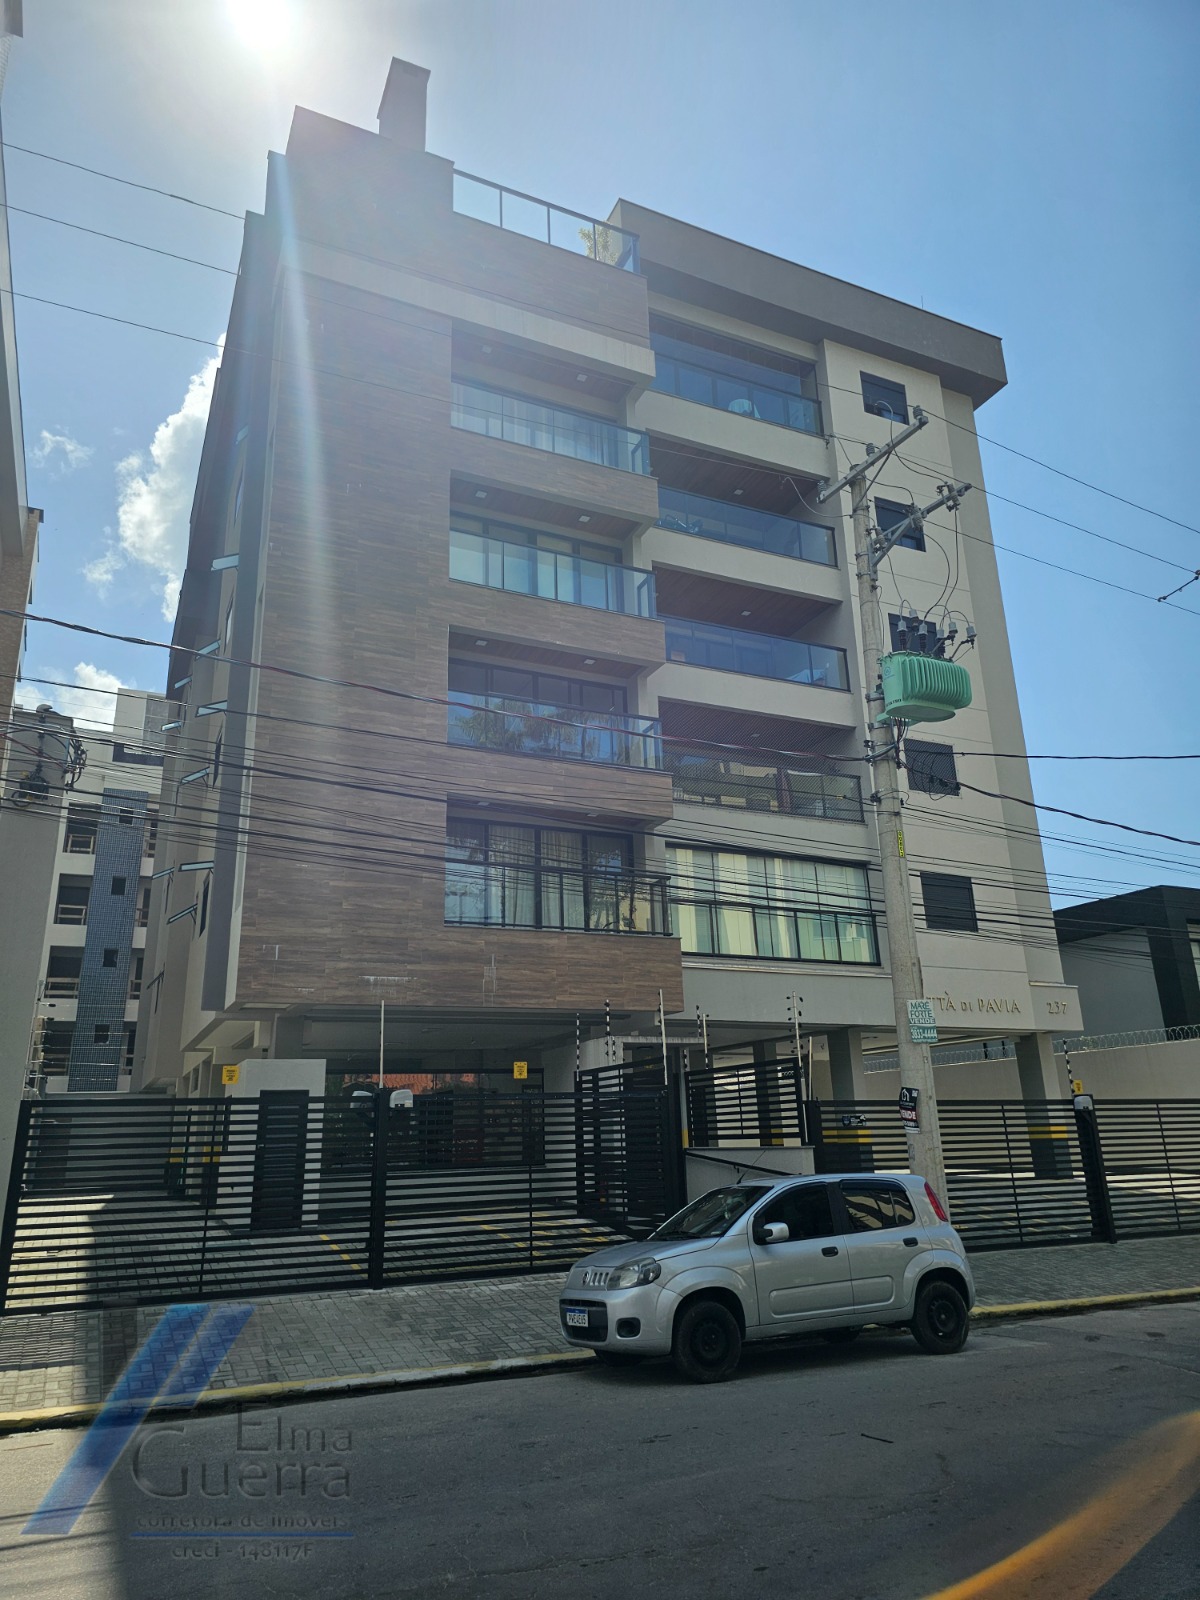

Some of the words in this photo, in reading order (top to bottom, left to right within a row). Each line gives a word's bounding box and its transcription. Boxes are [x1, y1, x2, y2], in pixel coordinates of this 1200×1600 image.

[978, 999, 1021, 1014] PAVIA
[1046, 1002, 1068, 1015] 237
[910, 1010, 933, 1018] FORTE
